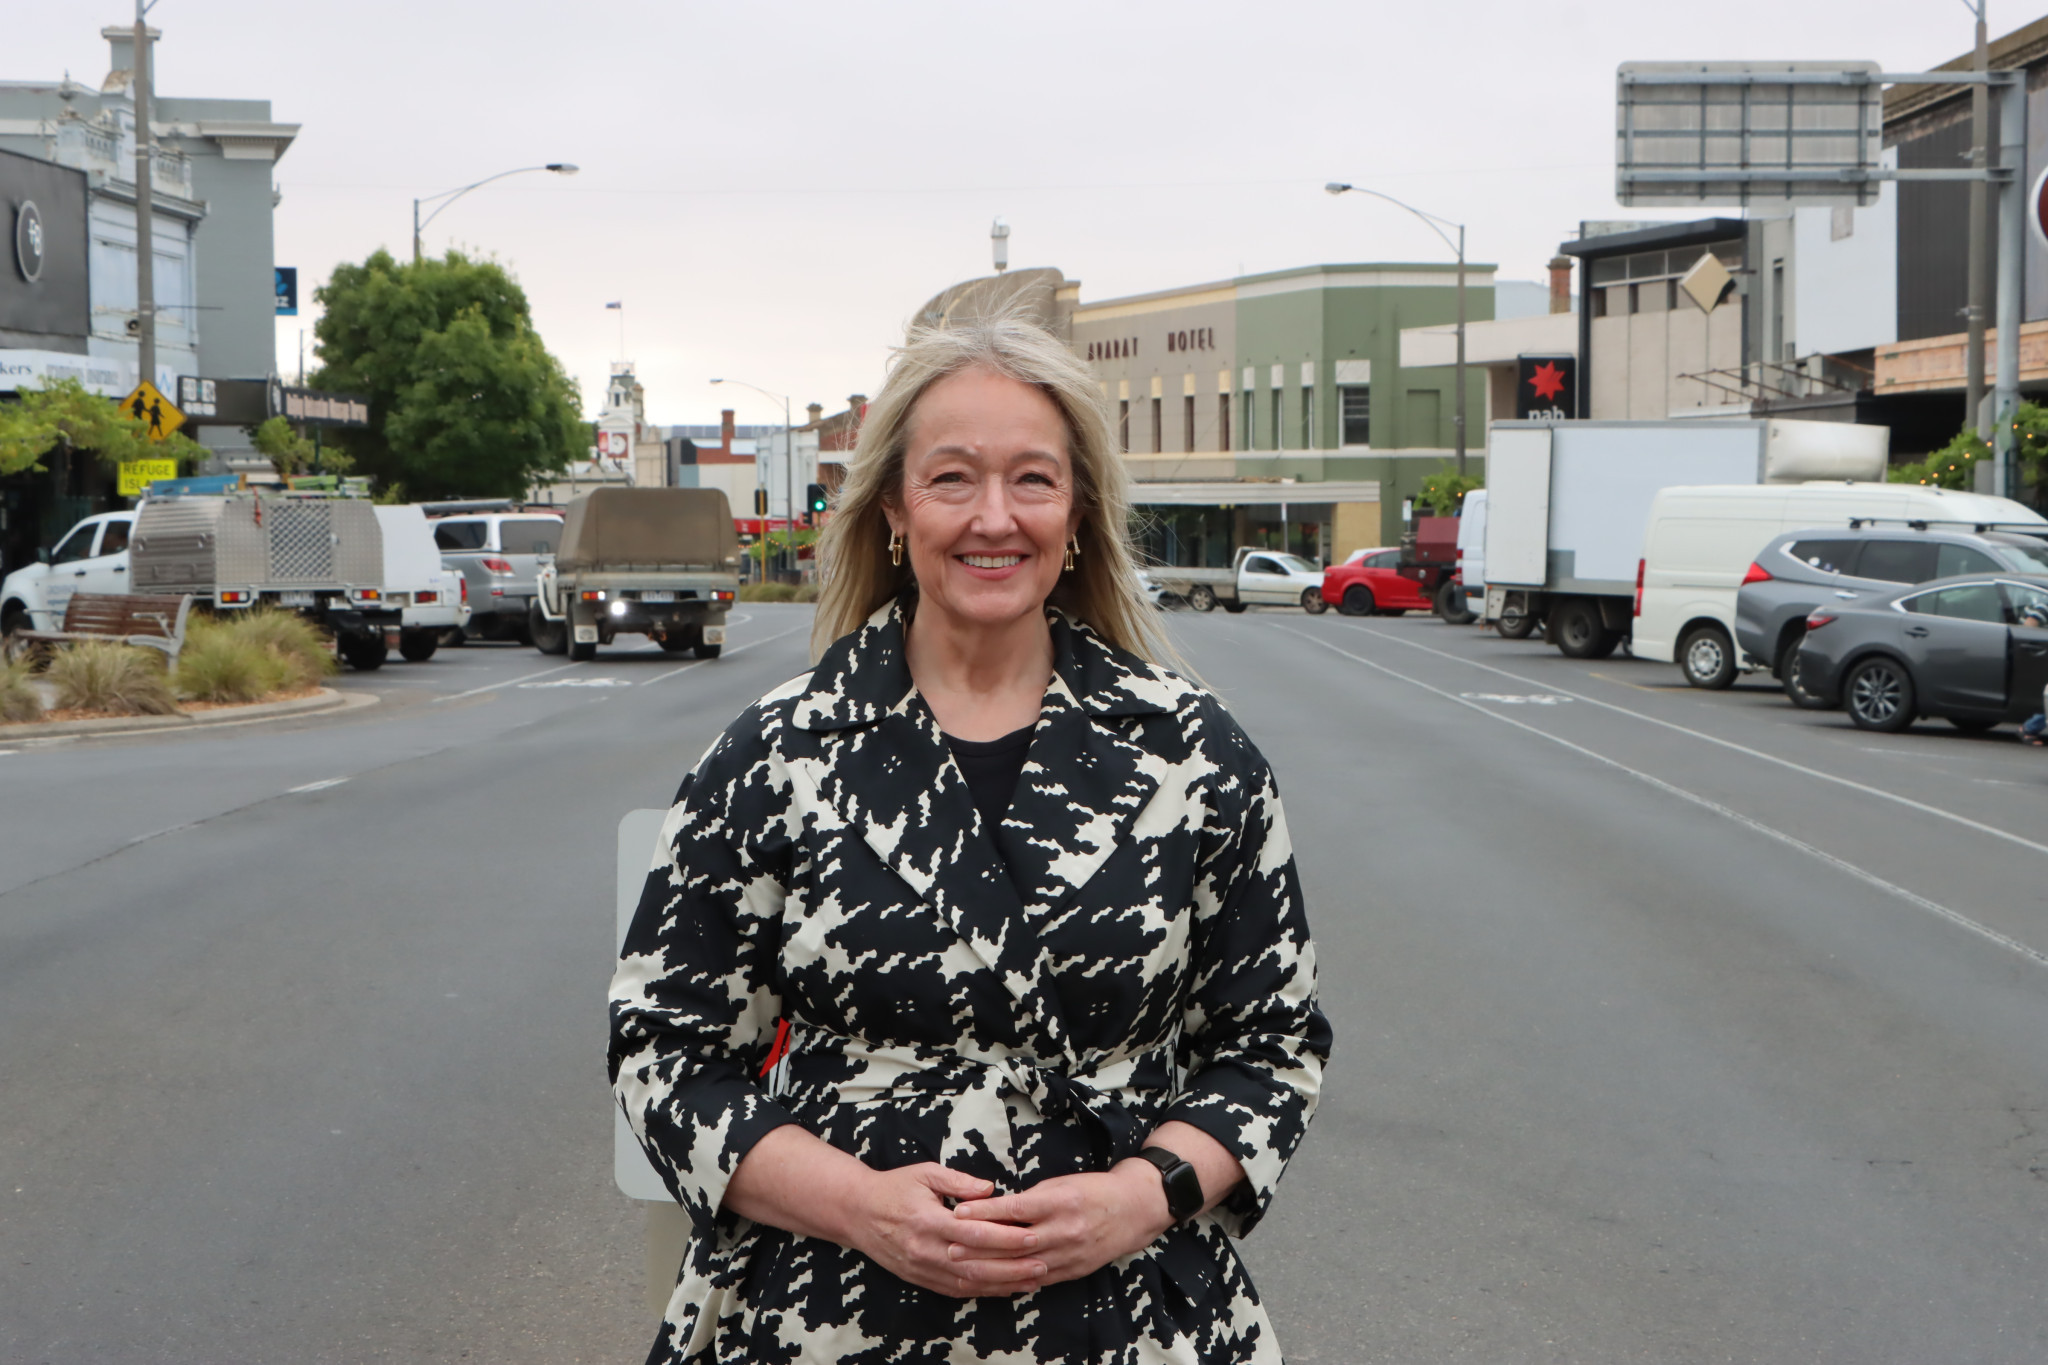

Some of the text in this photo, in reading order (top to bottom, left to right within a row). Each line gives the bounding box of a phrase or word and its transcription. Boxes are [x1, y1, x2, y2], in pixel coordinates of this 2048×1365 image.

[1087, 327, 1215, 361] ARARAT HOTEL
[122, 463, 171, 475] REFUGE
